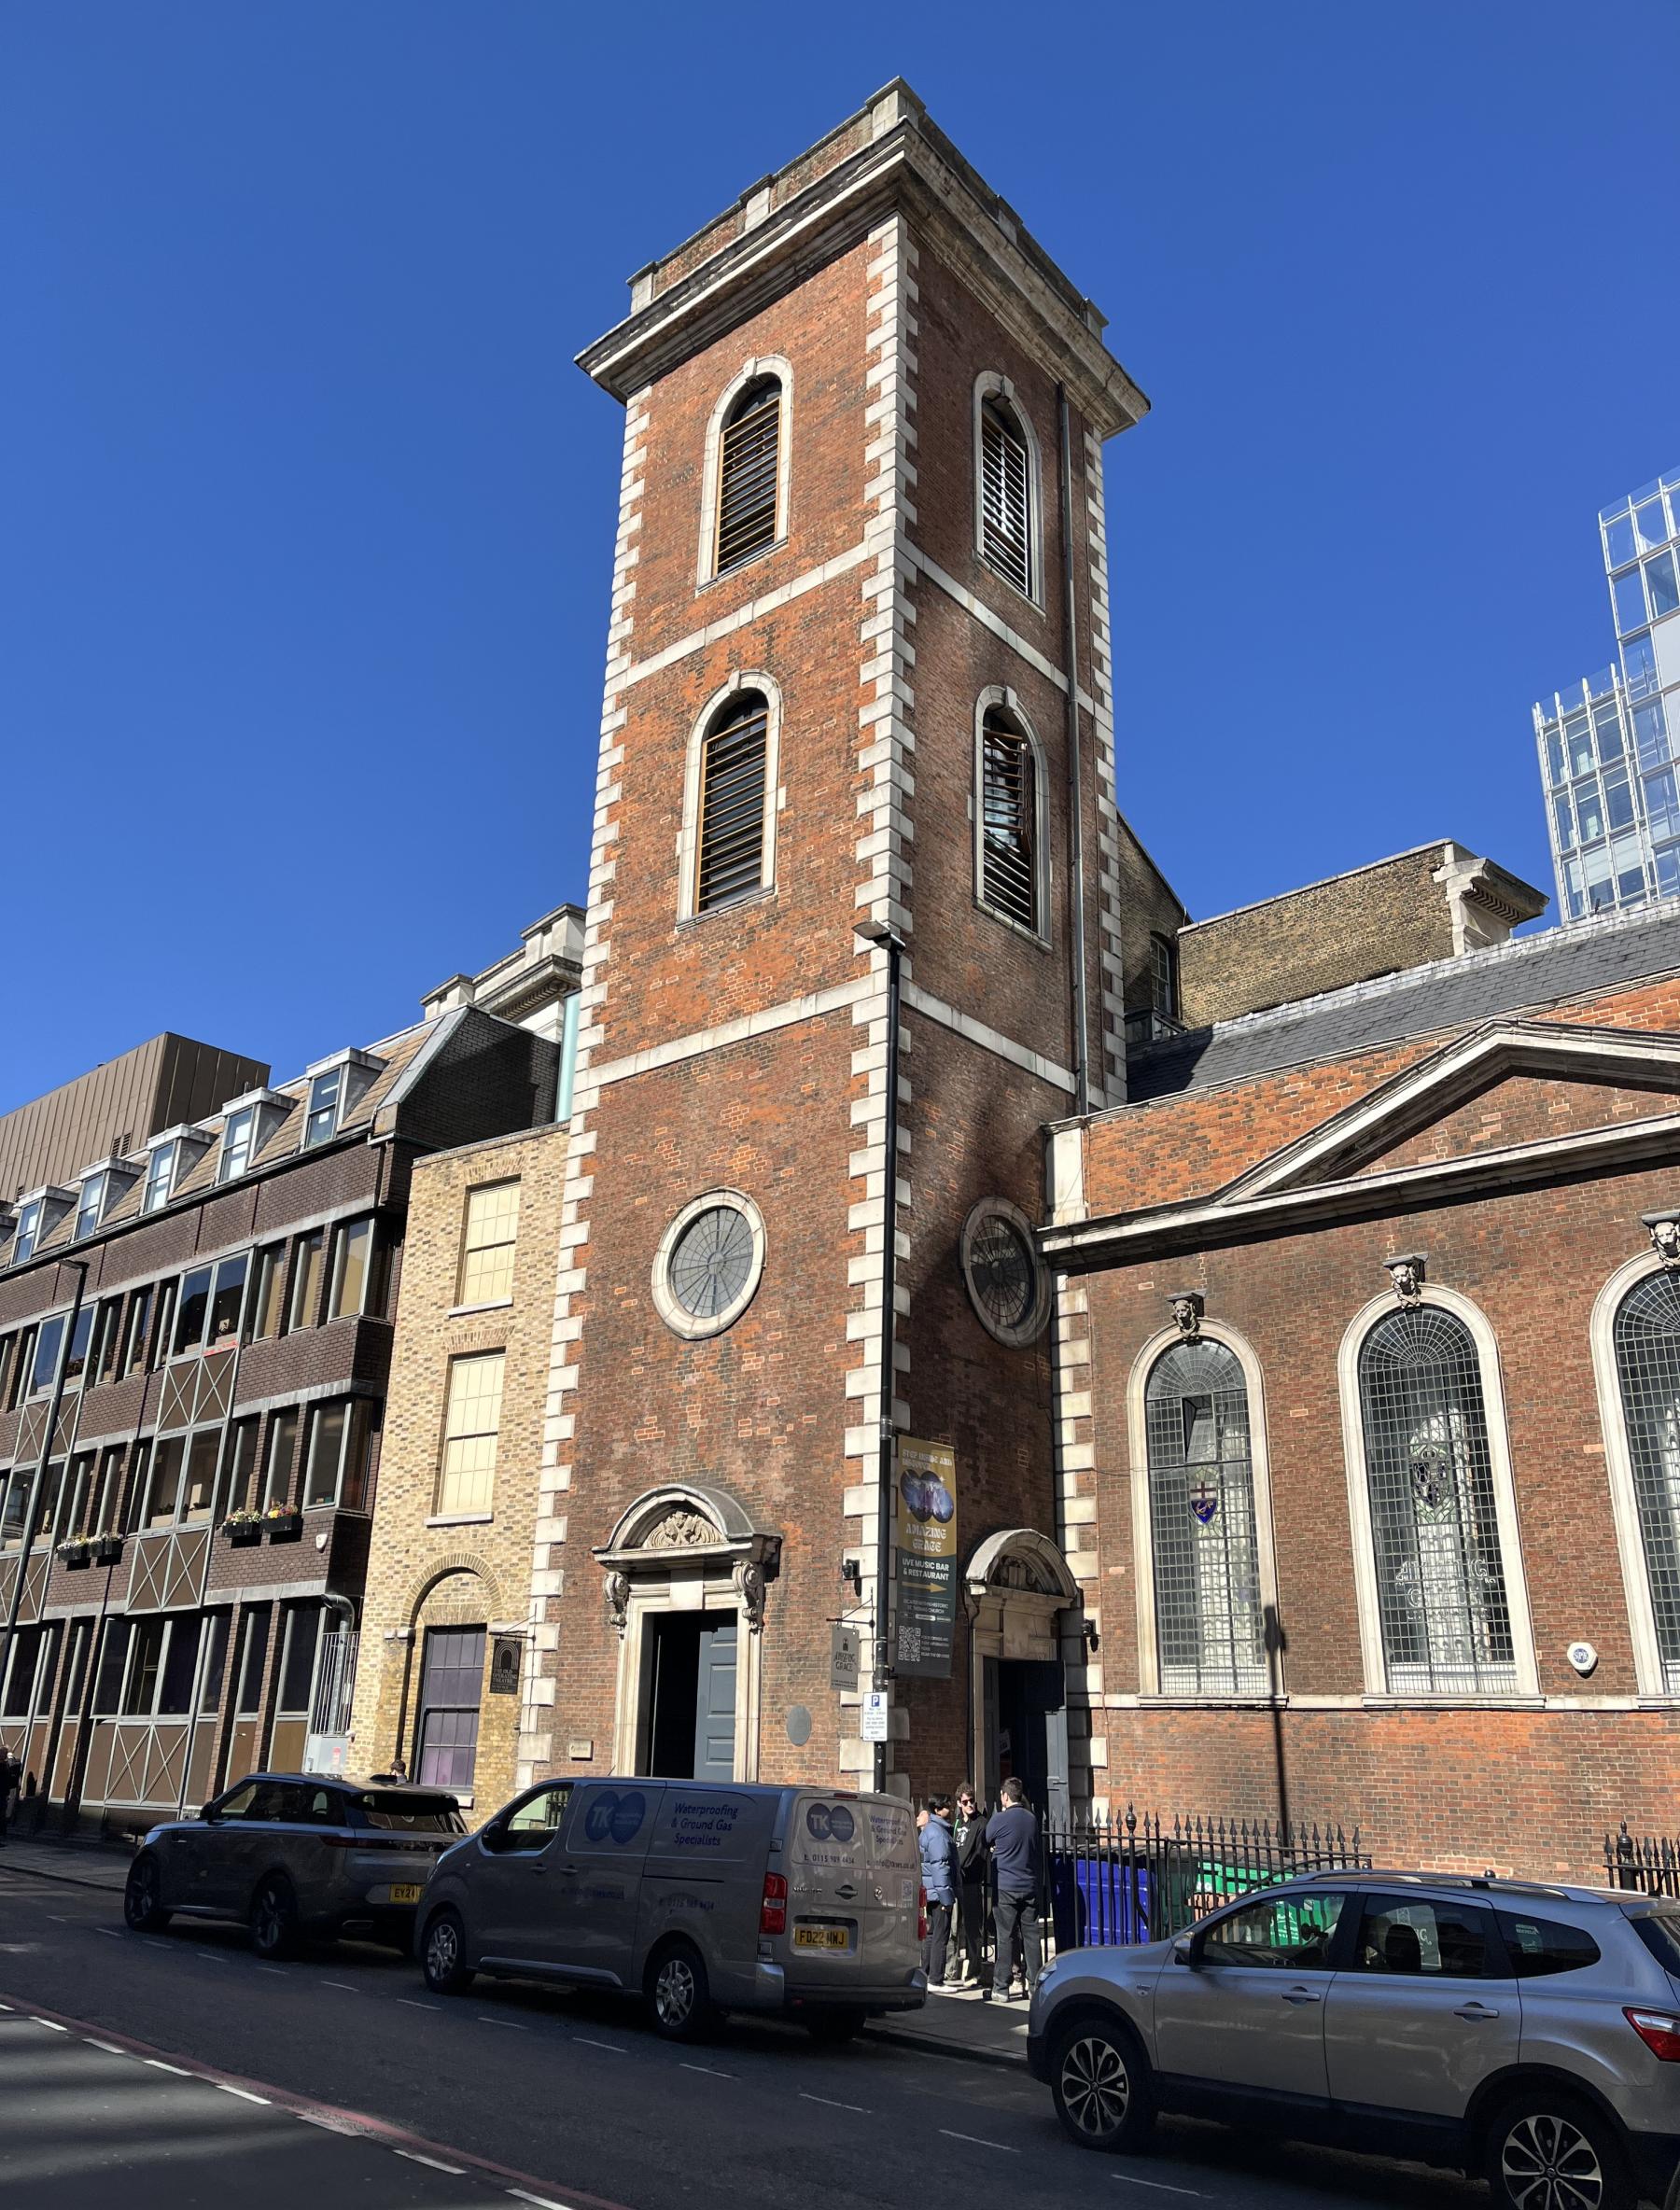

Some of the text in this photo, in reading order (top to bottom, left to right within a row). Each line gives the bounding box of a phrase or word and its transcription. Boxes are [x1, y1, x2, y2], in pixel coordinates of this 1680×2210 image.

[906, 1523, 946, 1540] AMAZING
[912, 1539, 942, 1553] GRACE
[902, 1558, 949, 1572] LIVE MUSIC BAR
[908, 1569, 950, 1581] RESTAURANT
[592, 1806, 615, 1828] TK
[674, 1802, 738, 1820] Waterproofing
[671, 1818, 732, 1831] & Ground Gas
[811, 1813, 830, 1831] TK
[674, 1833, 721, 1847] Specialists
[812, 1853, 828, 1863] 0115
[800, 1930, 824, 1943] FD22
